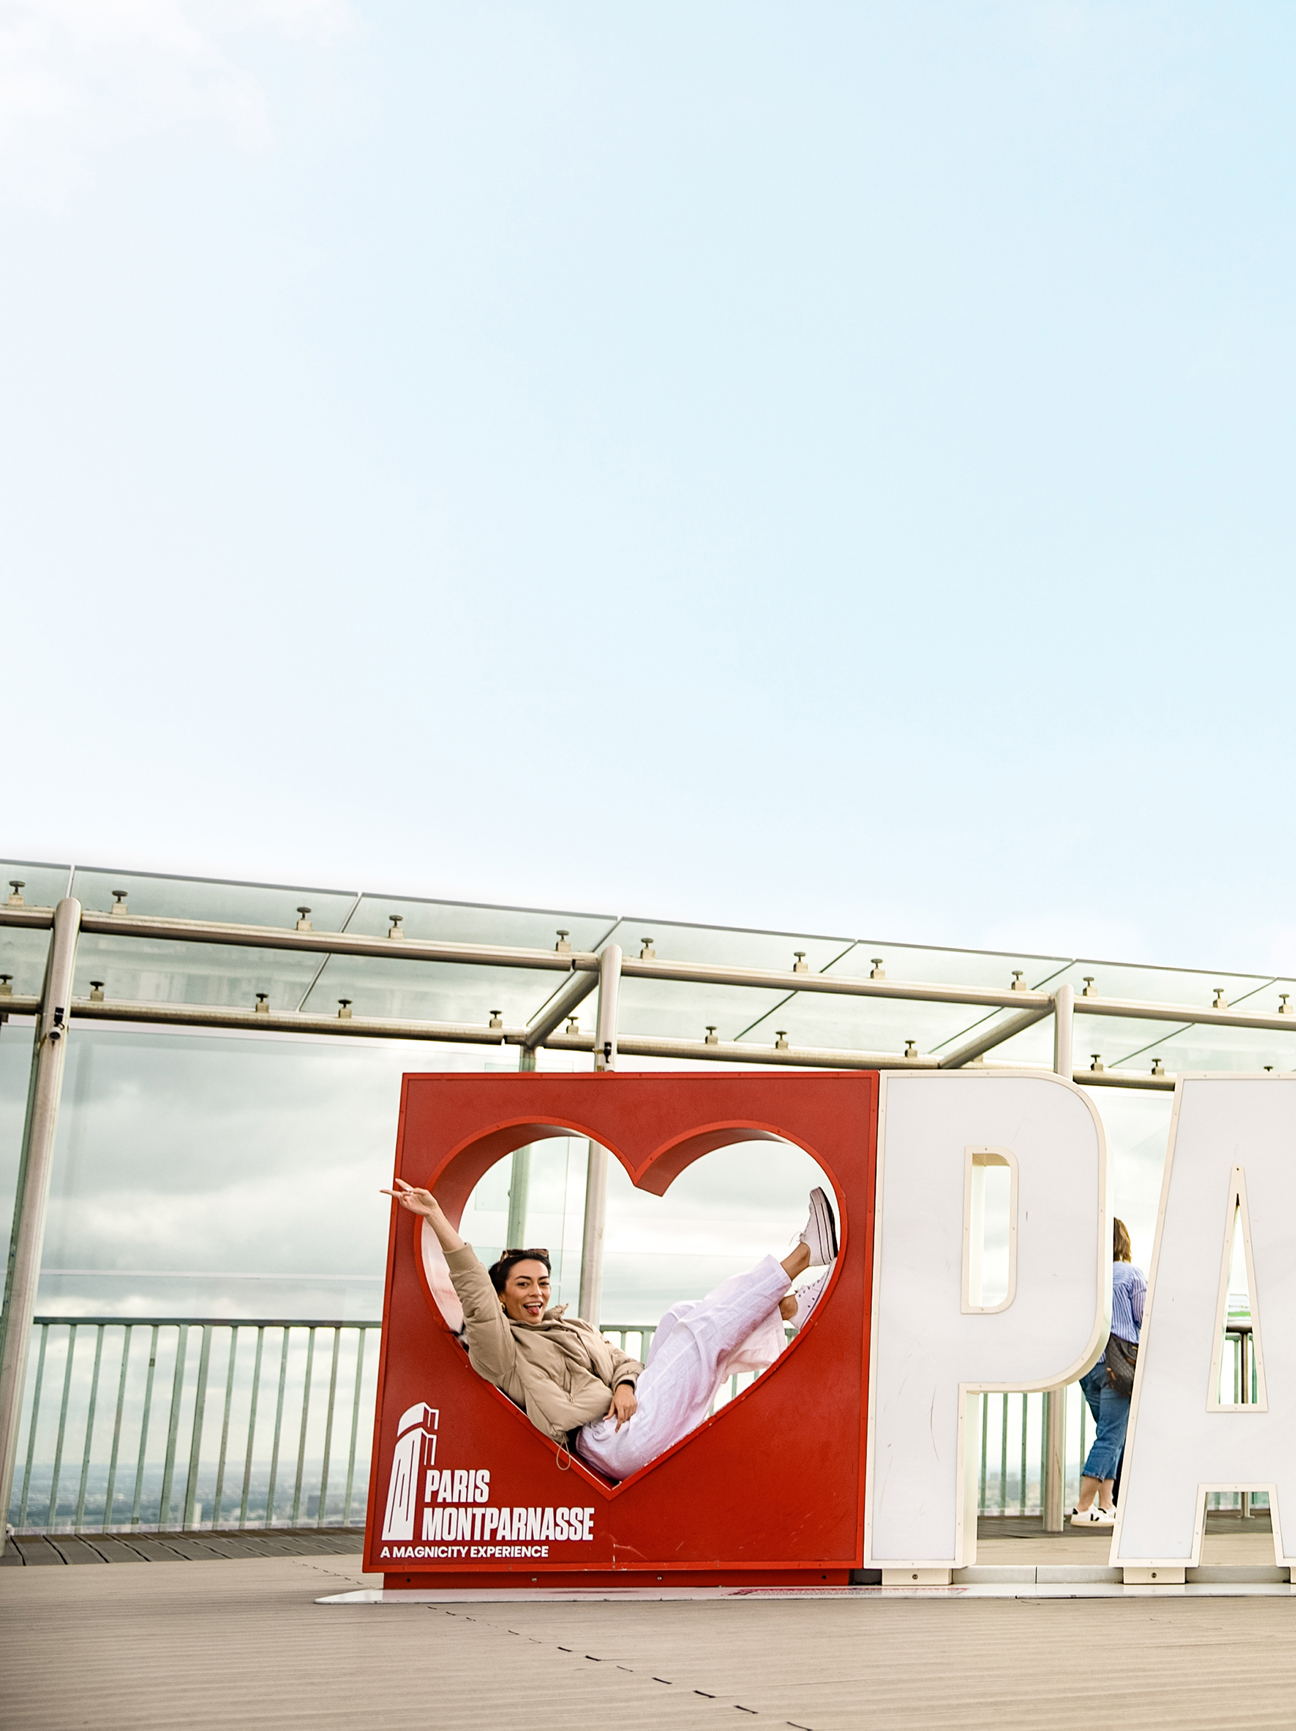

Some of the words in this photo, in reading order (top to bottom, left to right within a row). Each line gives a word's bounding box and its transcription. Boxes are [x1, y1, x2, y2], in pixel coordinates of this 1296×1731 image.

[424, 1469, 491, 1503] PARIS
[421, 1507, 595, 1541] MONTPARNASSE
[380, 1546, 391, 1557] A
[392, 1545, 468, 1558] MAGNICITY
[470, 1545, 549, 1558] EXPERIENCE
